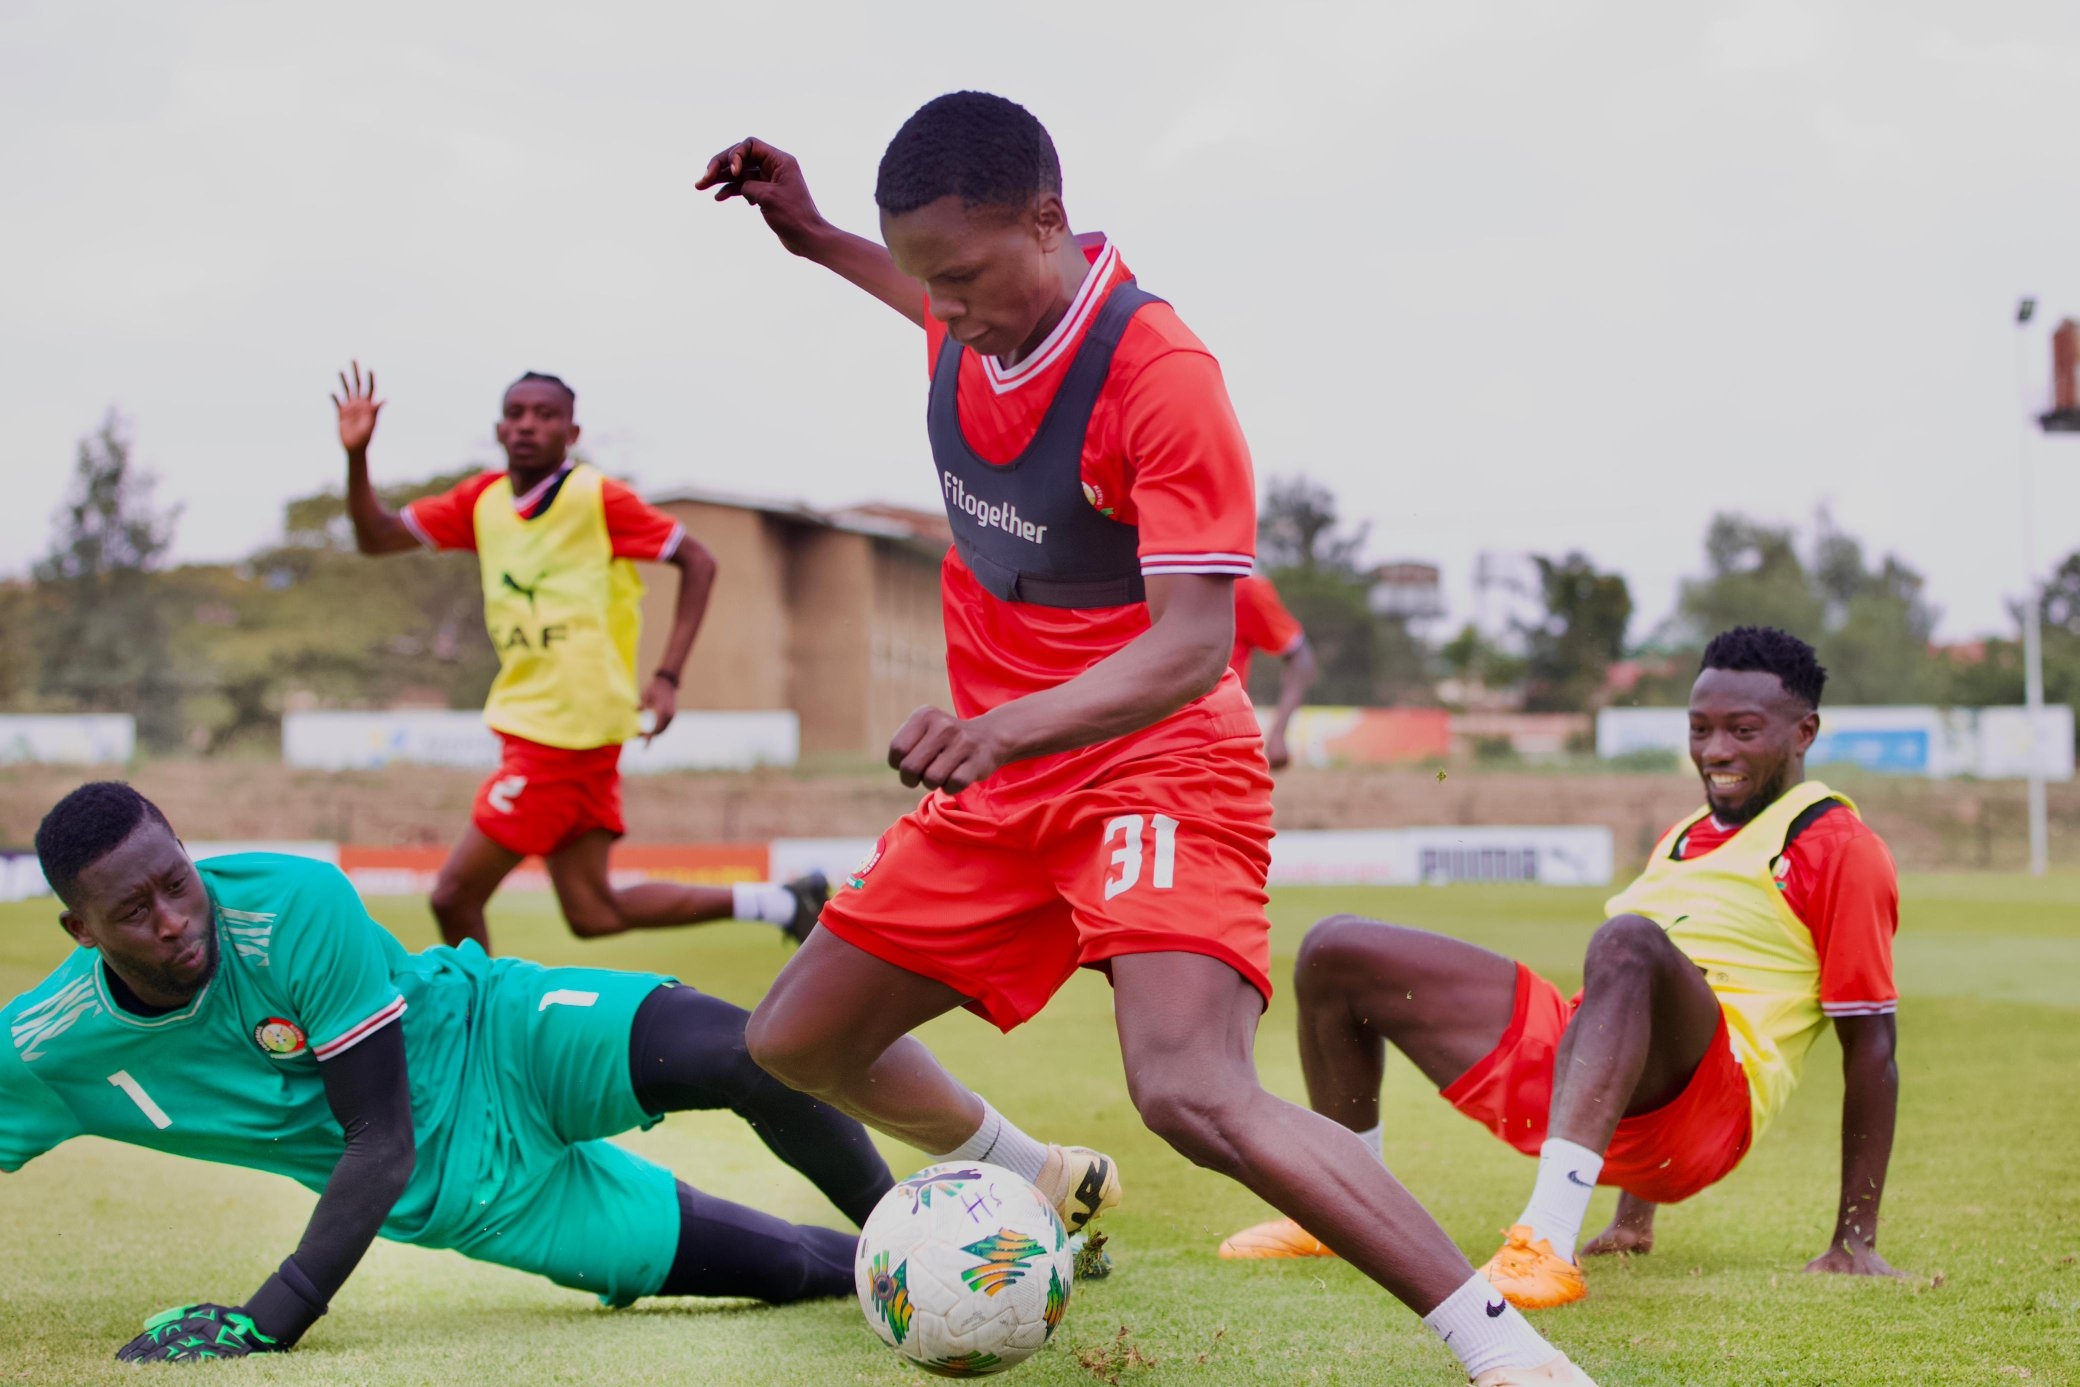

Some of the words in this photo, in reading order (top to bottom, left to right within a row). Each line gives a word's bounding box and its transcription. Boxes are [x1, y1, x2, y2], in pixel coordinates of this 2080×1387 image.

[944, 470, 1047, 545] Fitogether
[1104, 813, 1180, 901] 31
[538, 989, 599, 1011] 1
[106, 1069, 173, 1130] 1
